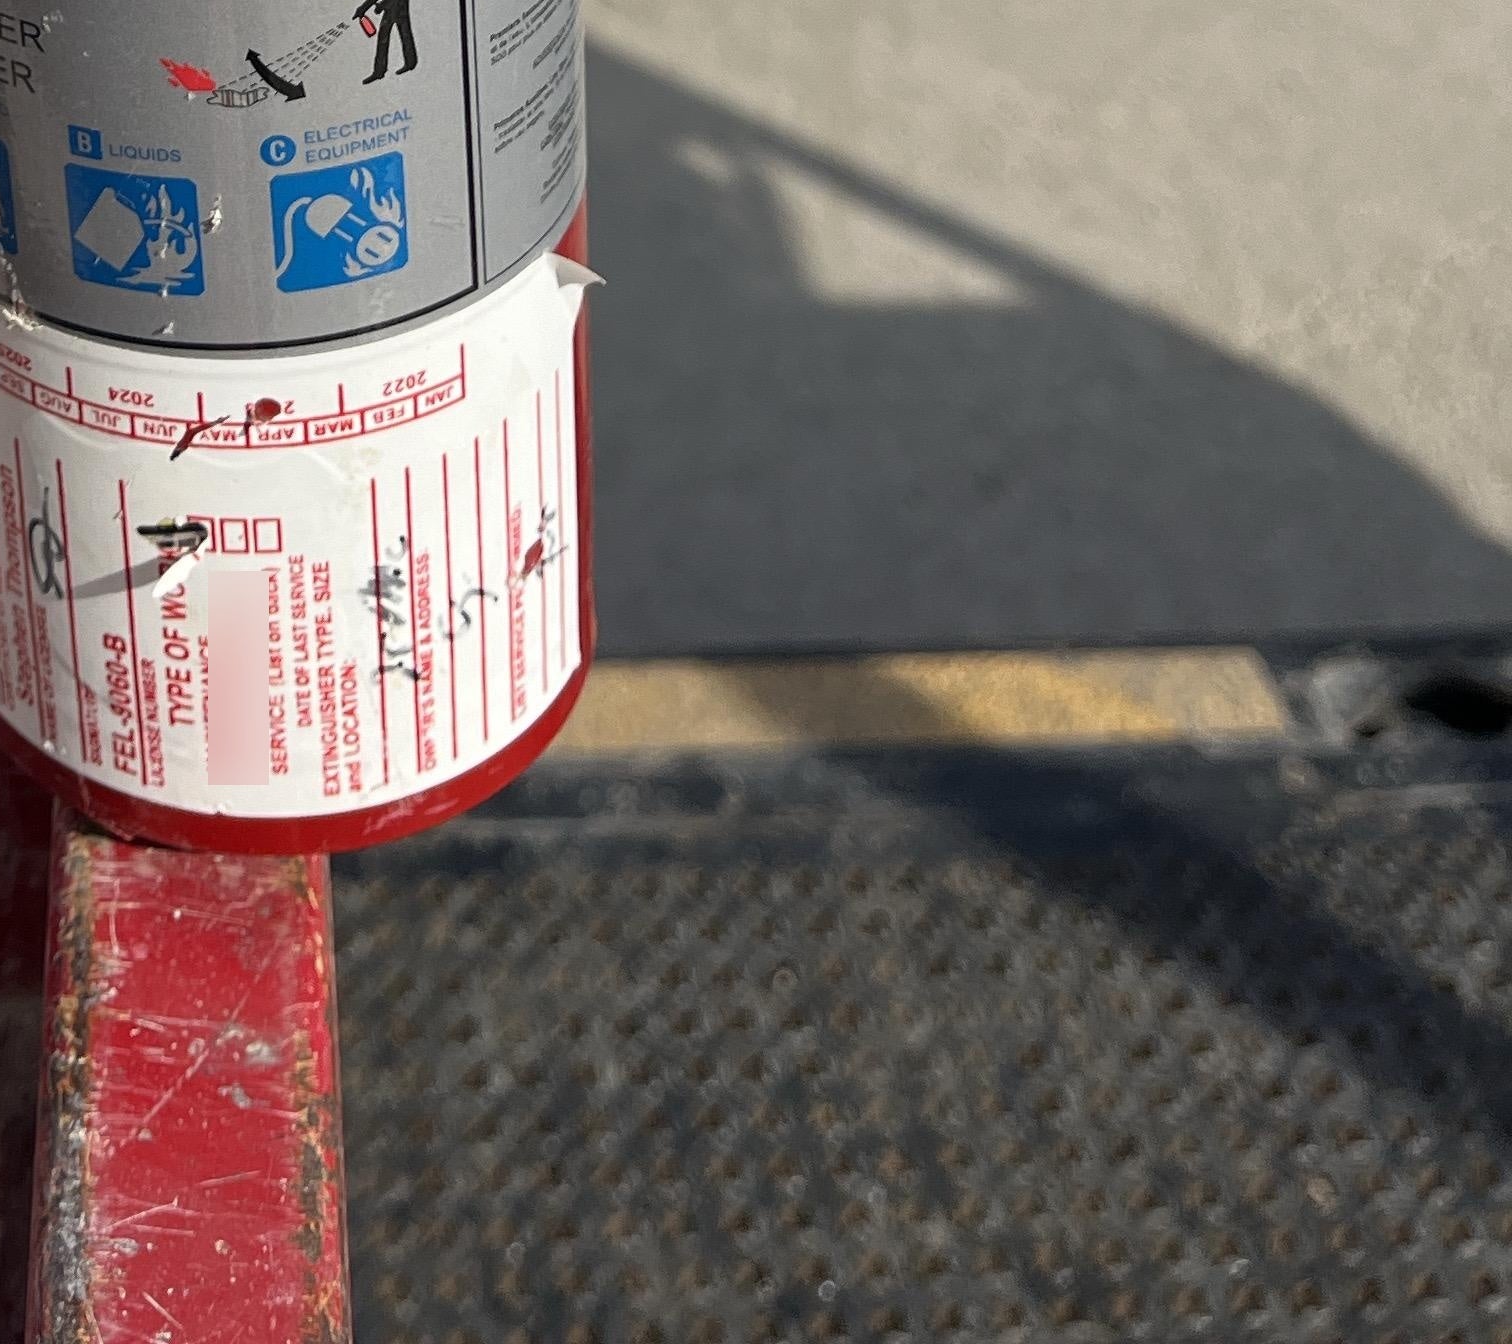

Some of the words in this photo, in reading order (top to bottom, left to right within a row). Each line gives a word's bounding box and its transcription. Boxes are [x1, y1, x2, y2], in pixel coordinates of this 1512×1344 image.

[304, 108, 413, 144] ELECTRICAL
[109, 144, 182, 163] LIQUIDS
[305, 126, 410, 163] EQUIPMENT
[108, 386, 155, 408] 2024
[383, 369, 427, 397] 2022
[425, 385, 454, 407] JAN
[40, 391, 72, 413] AUG
[92, 410, 122, 427] JUL
[373, 403, 405, 424] FEB
[142, 422, 178, 438] JUN
[200, 425, 238, 441] MAY
[259, 426, 295, 442] APR
[315, 418, 353, 437] MAR
[0, 463, 24, 598] Thompson
[289, 552, 307, 620] SERVICE
[313, 560, 331, 603] SIZE
[162, 625, 190, 660] OF
[292, 624, 309, 662] LAST
[141, 656, 159, 720] NUMBER
[294, 666, 310, 687] OF
[419, 648, 434, 695] NAME
[103, 632, 137, 776] FEL-9060-B
[165, 666, 194, 727] TYPE
[294, 689, 312, 728] DATE
[341, 657, 361, 758] LOCATION:
[269, 693, 288, 776] SERVICE
[318, 663, 339, 797] EXTINGUISHER
